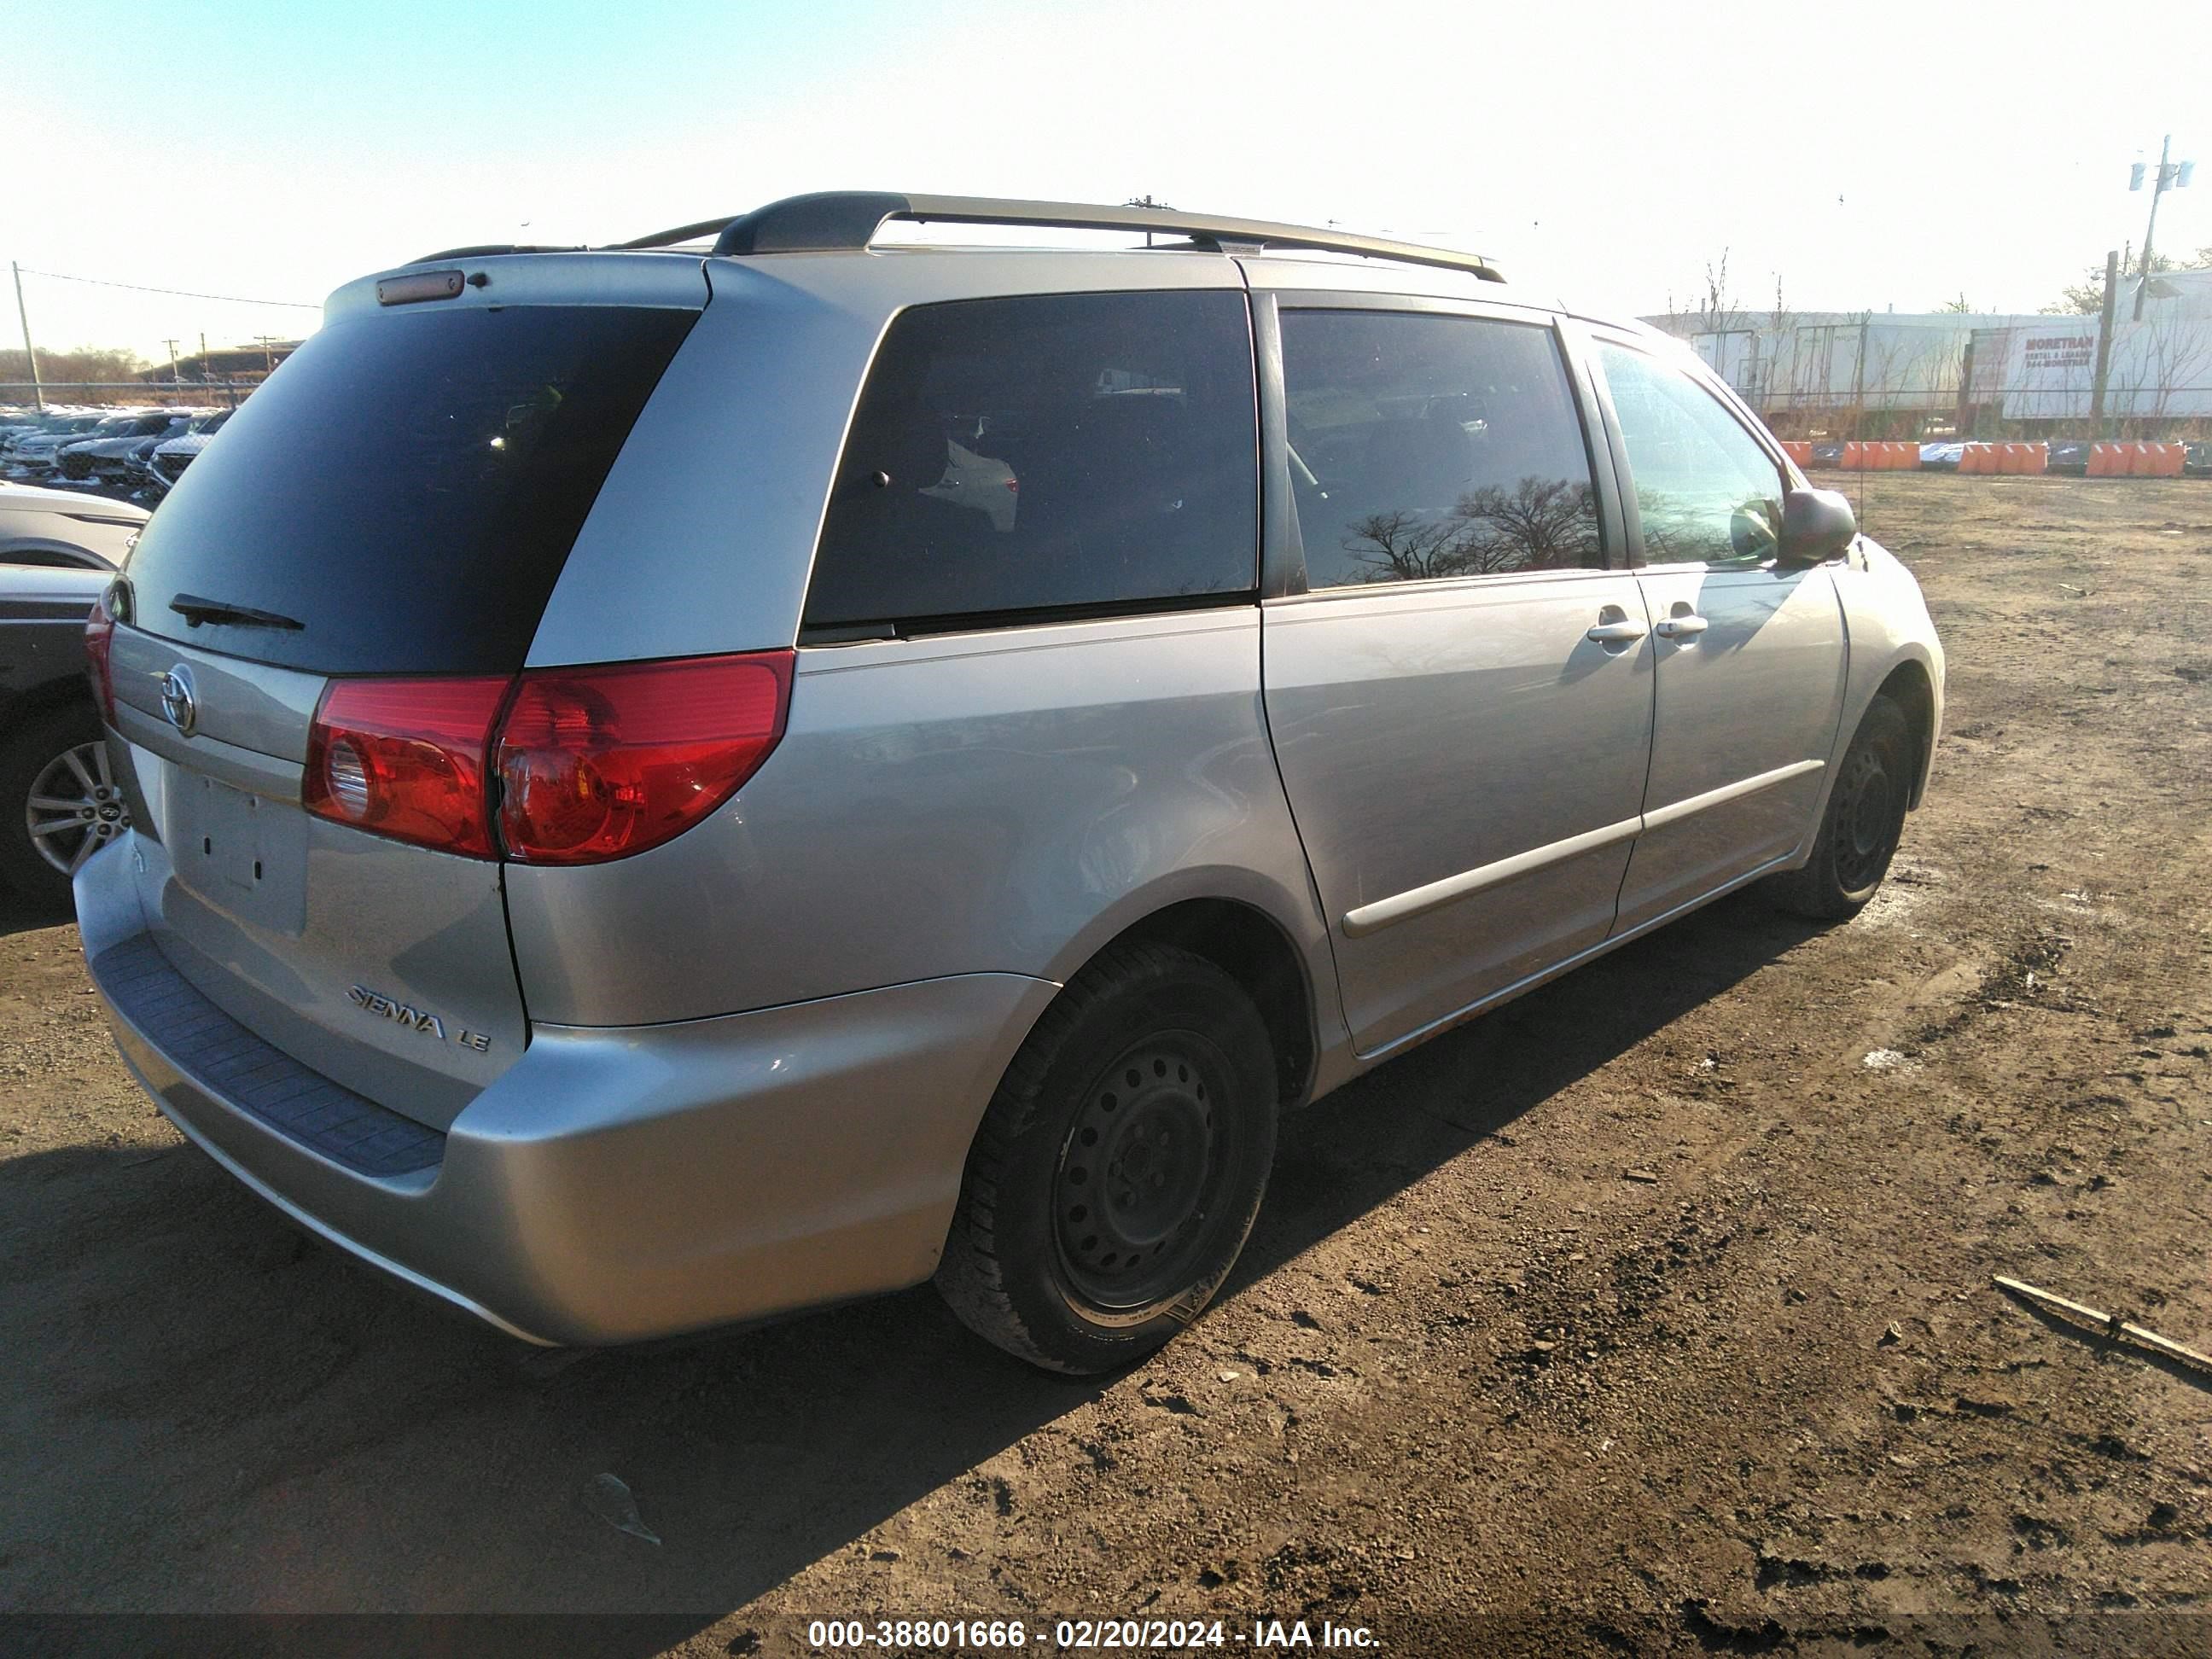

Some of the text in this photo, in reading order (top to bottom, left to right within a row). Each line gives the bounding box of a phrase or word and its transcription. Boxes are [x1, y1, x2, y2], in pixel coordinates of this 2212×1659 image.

[2025, 336, 2093, 350] MORETRAN
[346, 984, 492, 1053] SIENNA LE
